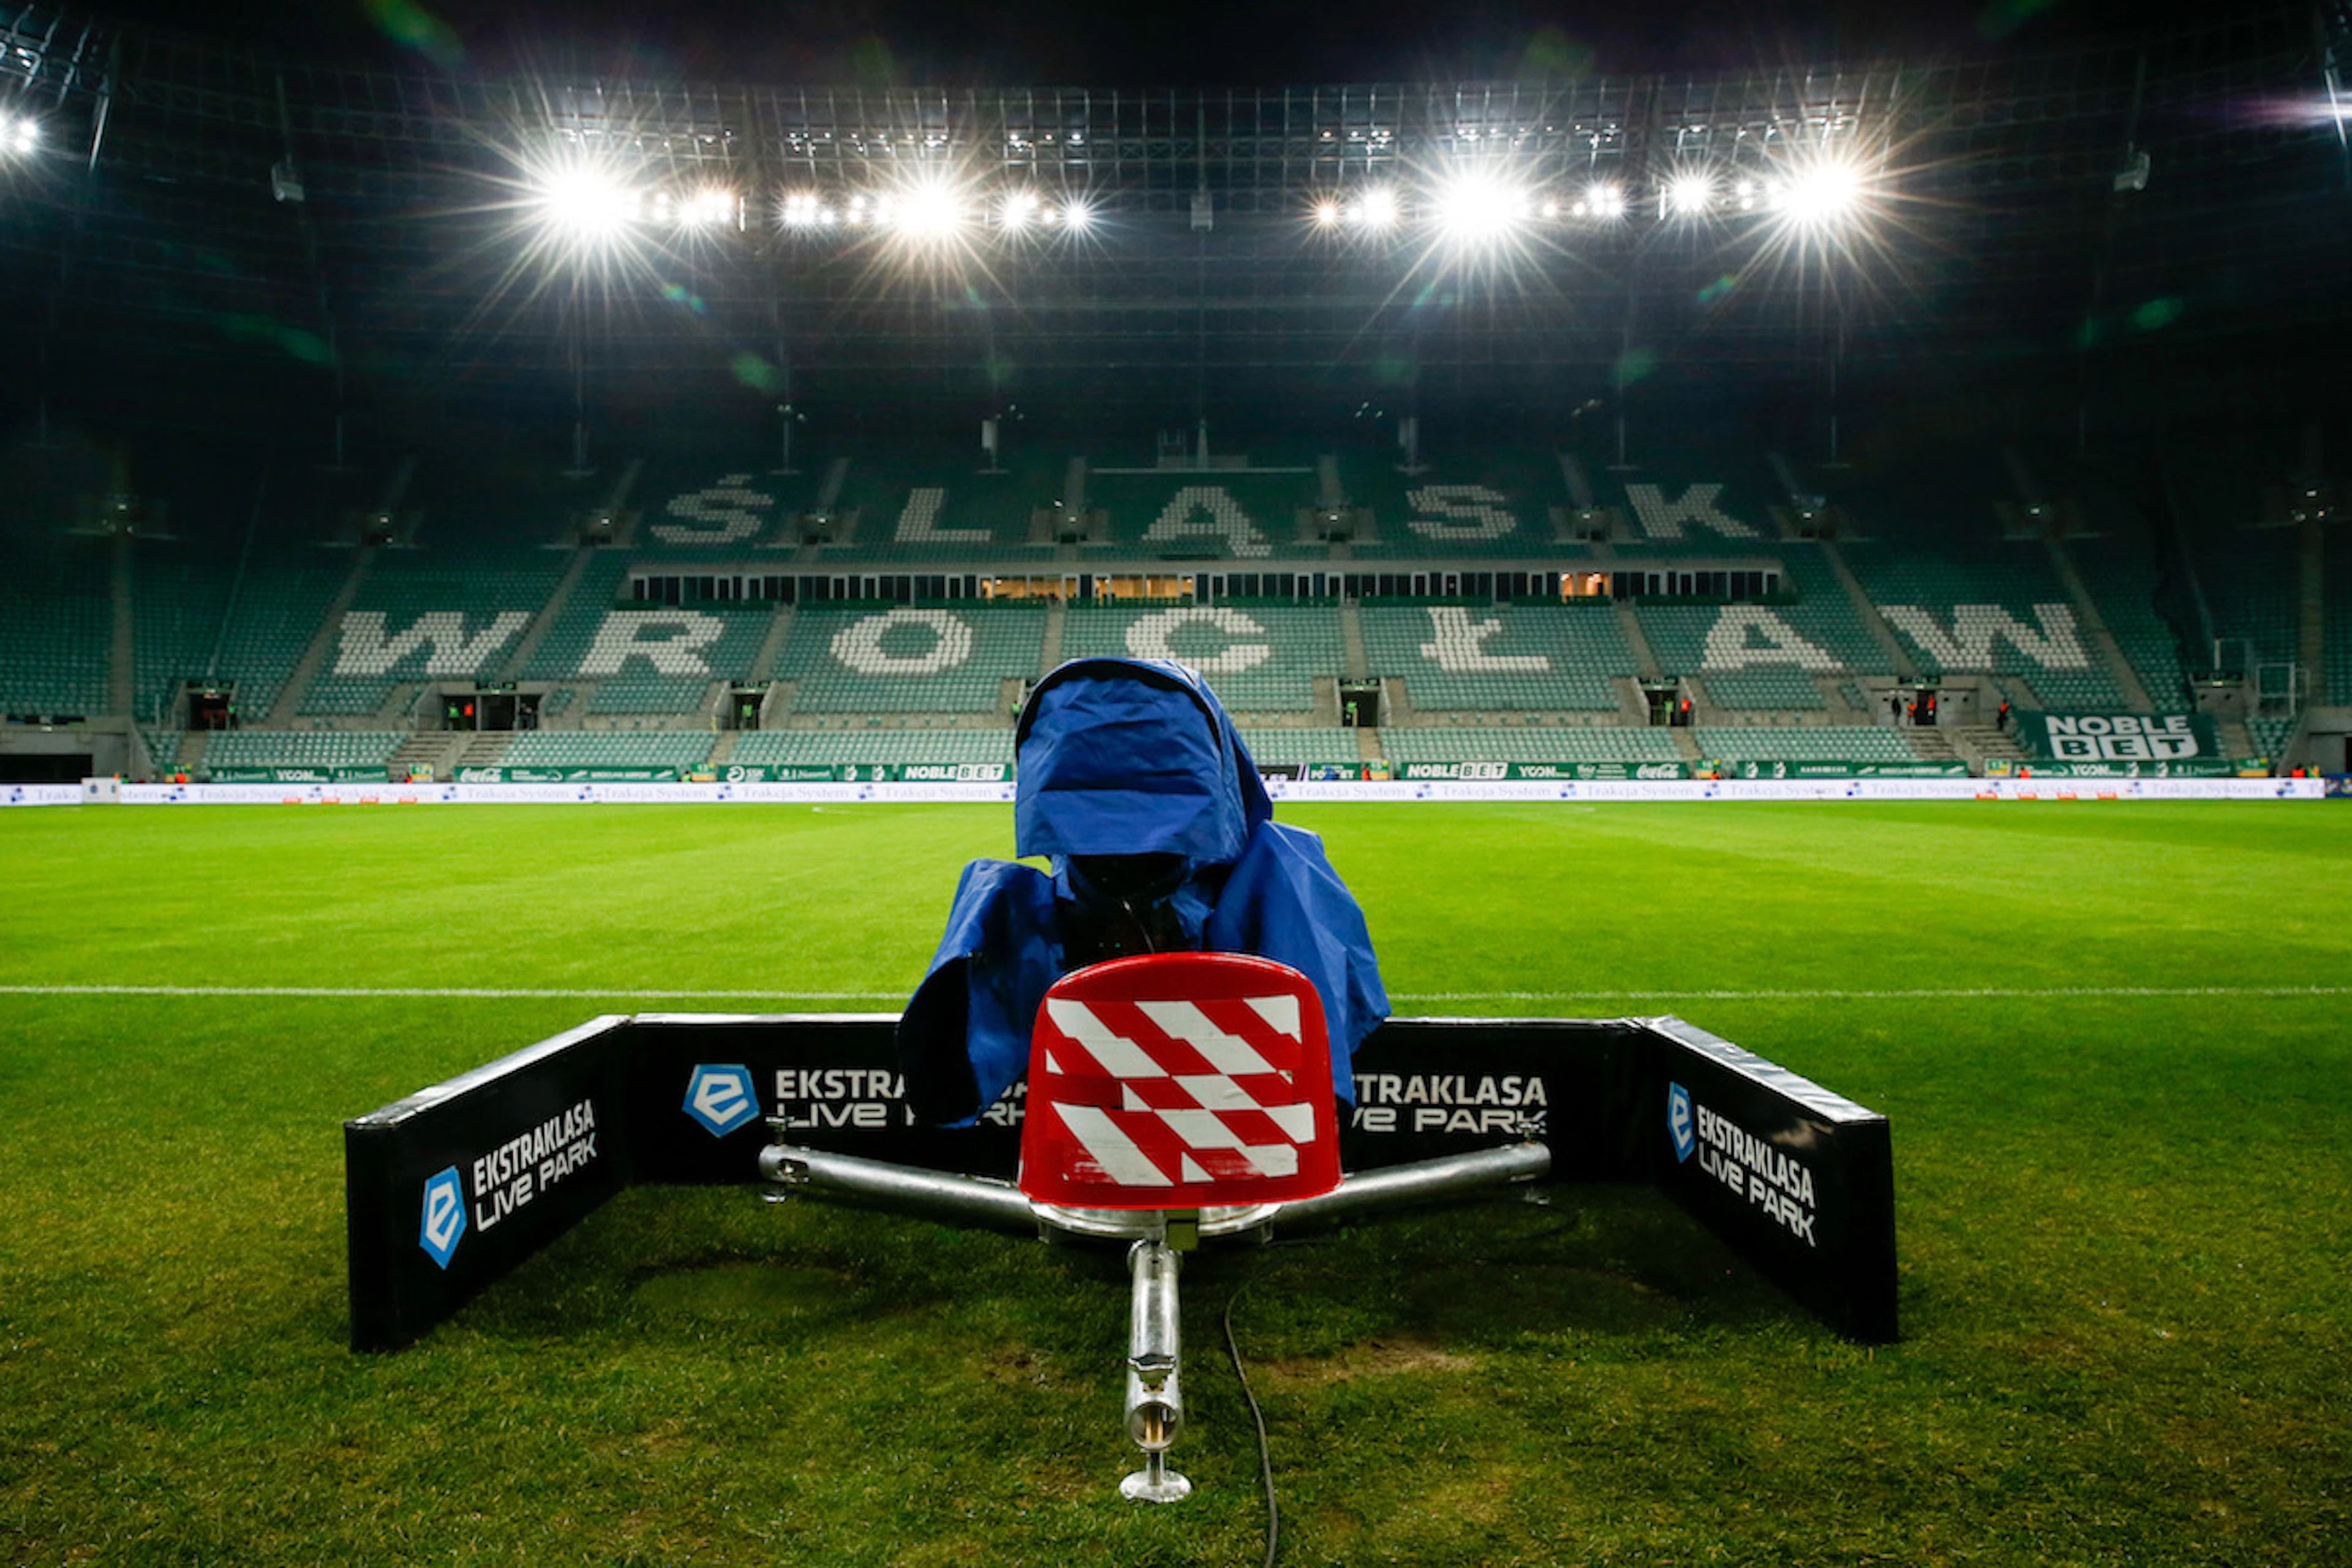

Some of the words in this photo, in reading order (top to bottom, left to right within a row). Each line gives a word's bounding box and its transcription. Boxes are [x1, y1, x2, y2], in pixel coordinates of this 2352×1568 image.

[333, 601, 2089, 678] WROCŁAW
[2045, 715, 2192, 734] NOBLE
[2049, 735, 2199, 760] BET
[1352, 1074, 1548, 1106] TRAKLASA
[473, 1099, 595, 1197] EKSTRAKLASA
[539, 1133, 597, 1191] PARK
[1697, 1104, 1815, 1208] EKSTRAKLASA
[1749, 1175, 1816, 1248] PARK
